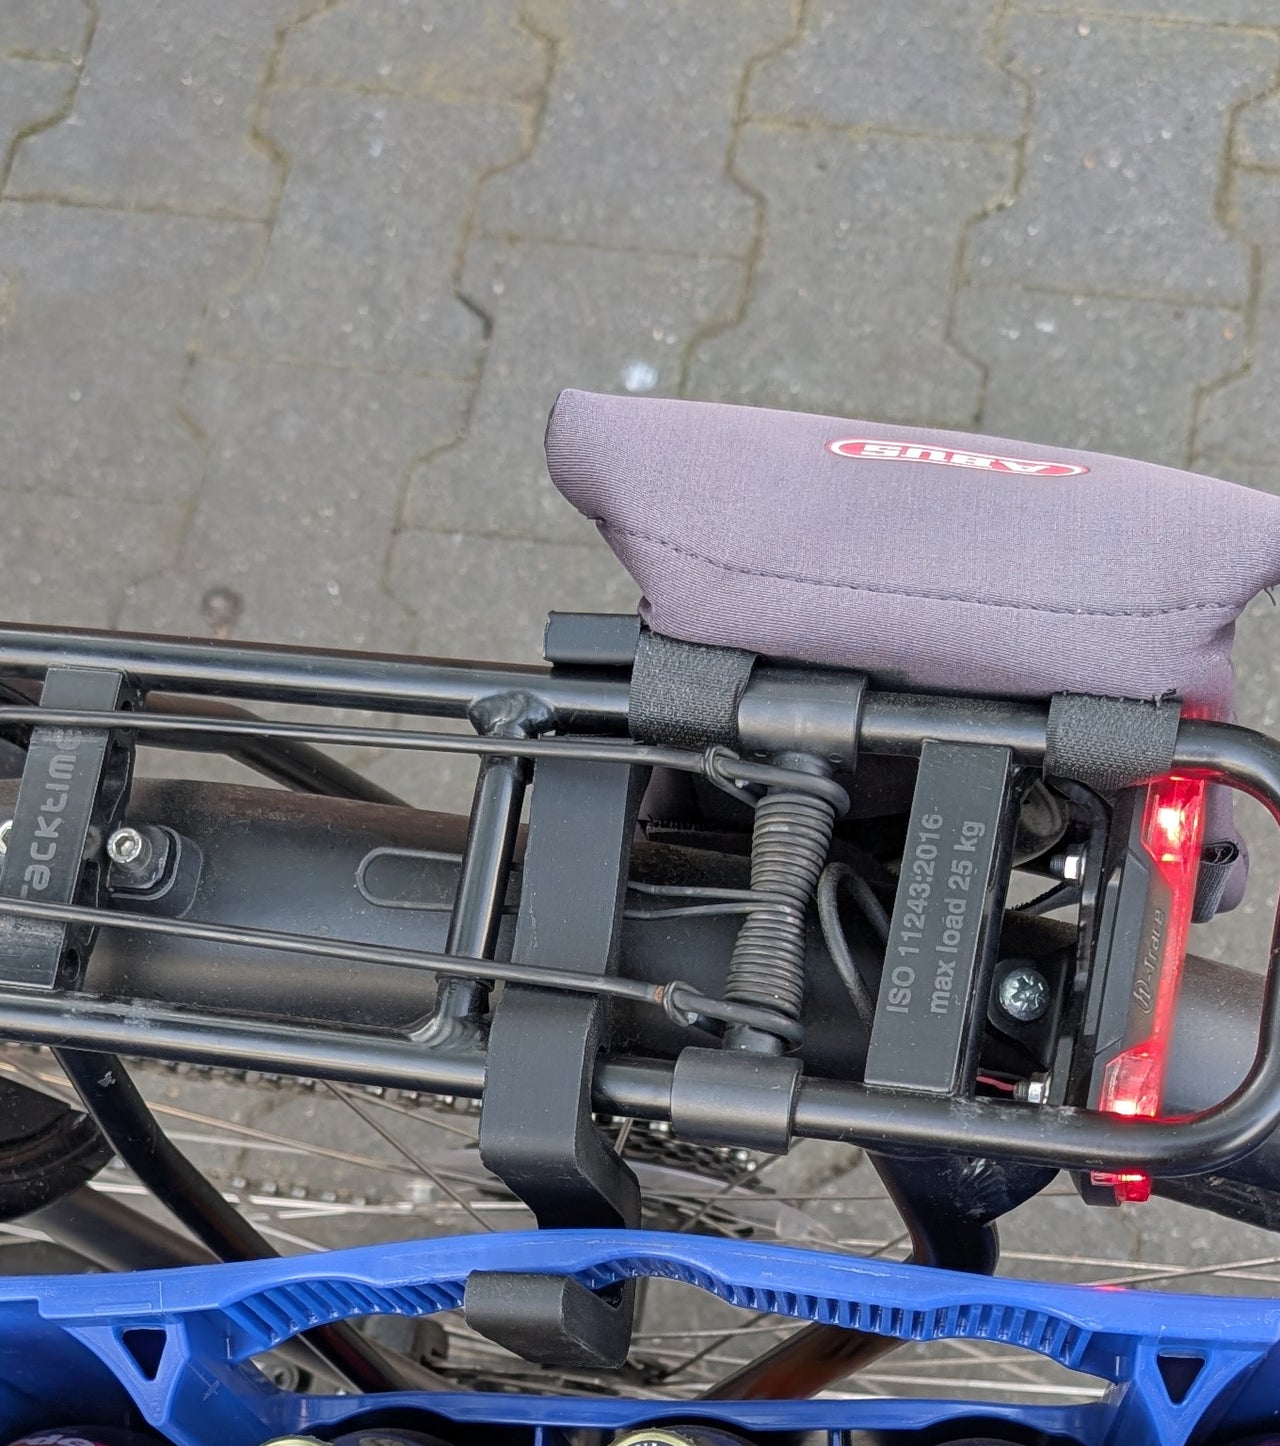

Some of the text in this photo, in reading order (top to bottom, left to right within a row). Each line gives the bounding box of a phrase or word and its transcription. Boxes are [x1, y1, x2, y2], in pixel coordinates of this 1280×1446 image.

[860, 444, 1052, 473] ABUS
[886, 813, 944, 1014] ISO 11243:2016
[929, 820, 986, 1015] max load 25 kg
